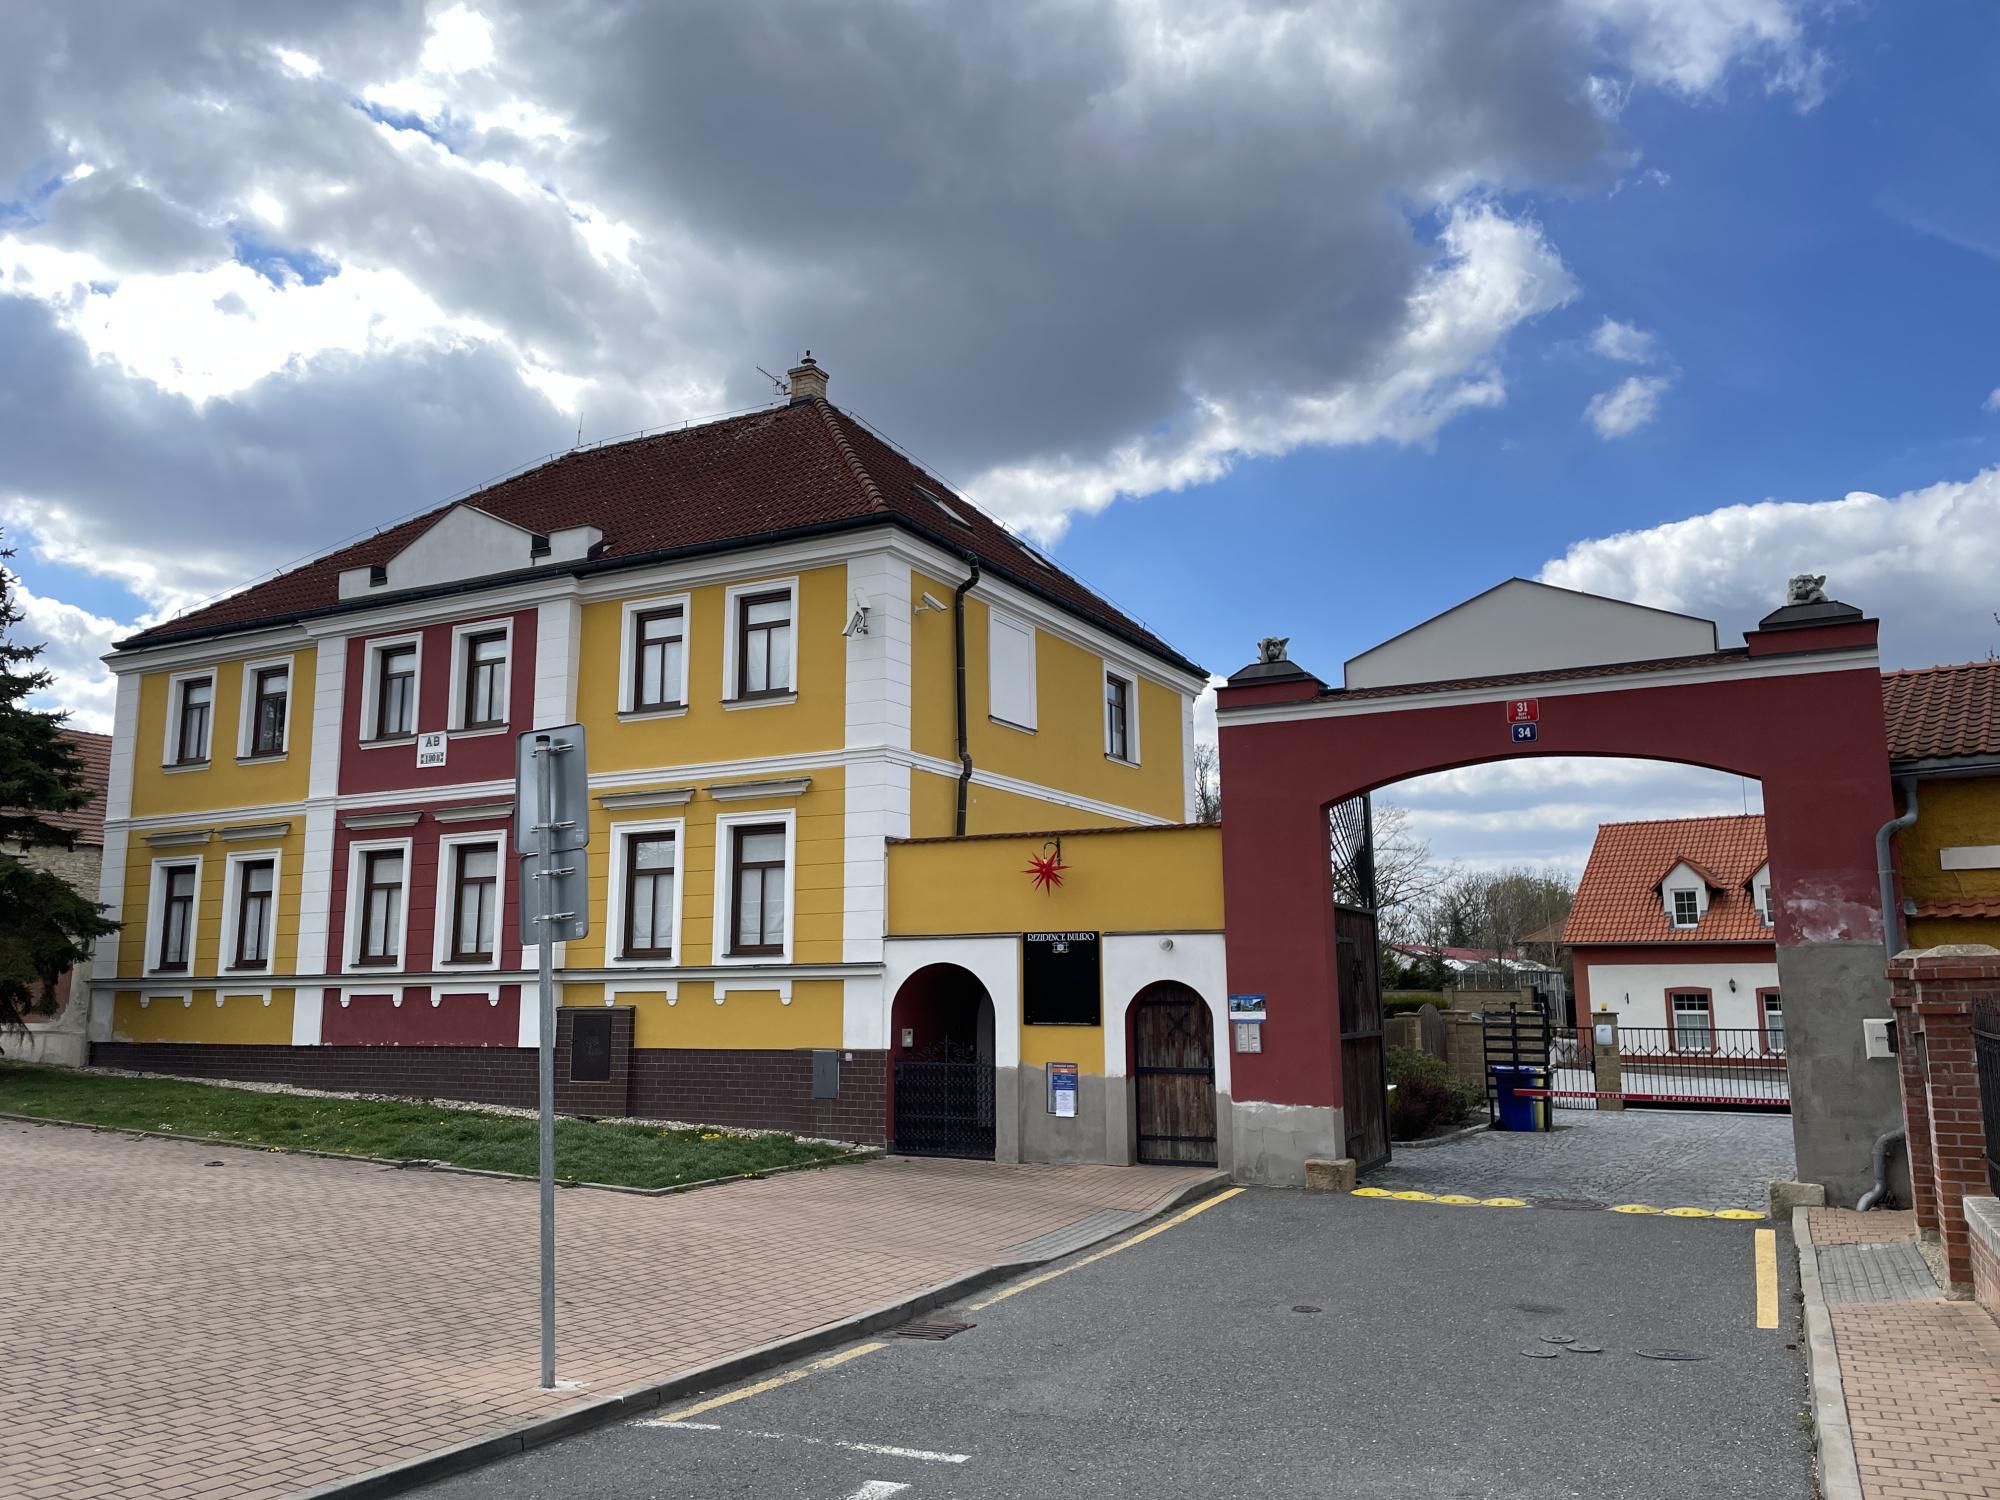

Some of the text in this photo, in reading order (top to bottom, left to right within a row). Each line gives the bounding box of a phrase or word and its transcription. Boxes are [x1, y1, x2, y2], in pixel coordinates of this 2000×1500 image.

[1517, 702, 1528, 712] 31
[1518, 727, 1531, 738] 34
[1027, 933, 1066, 942] REZIDENCE
